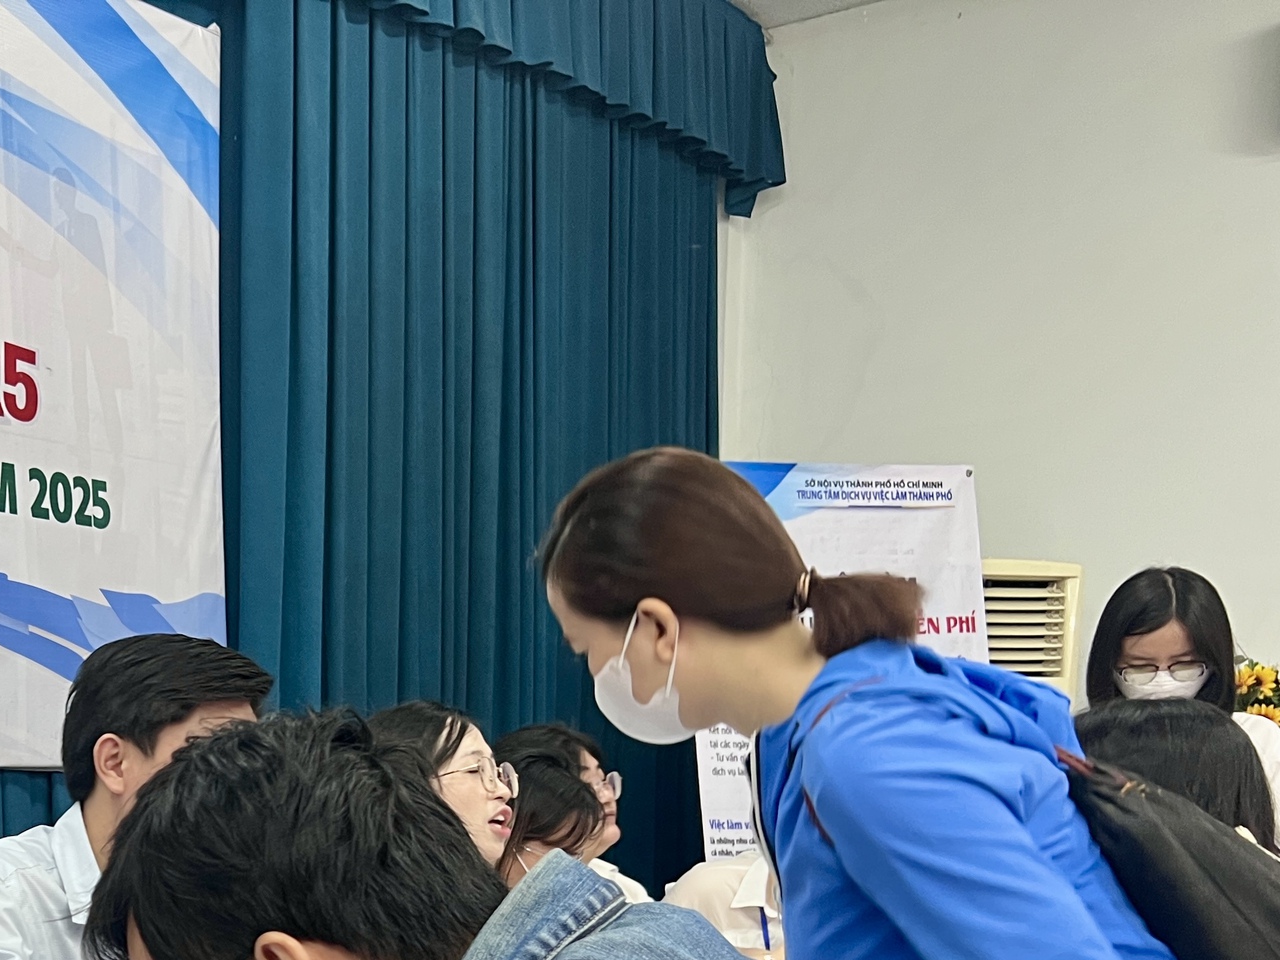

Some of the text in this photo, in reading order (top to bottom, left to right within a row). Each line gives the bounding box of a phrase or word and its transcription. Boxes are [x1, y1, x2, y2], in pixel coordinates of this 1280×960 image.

[833, 481, 845, 490] VỤ
[846, 480, 873, 488] THÀNH
[875, 478, 892, 488] PHỐ
[907, 479, 920, 488] CHÍ
[921, 481, 943, 489] MINH
[29, 467, 111, 530] 2025
[797, 488, 953, 502] TRUNG TÂM DỊCH VỤ VIỆC LÀM THÀNH PHỐ
[946, 610, 977, 633] PHÍ
[732, 740, 749, 751] ngày
[709, 819, 725, 833] Việc
[727, 819, 742, 830] làm
